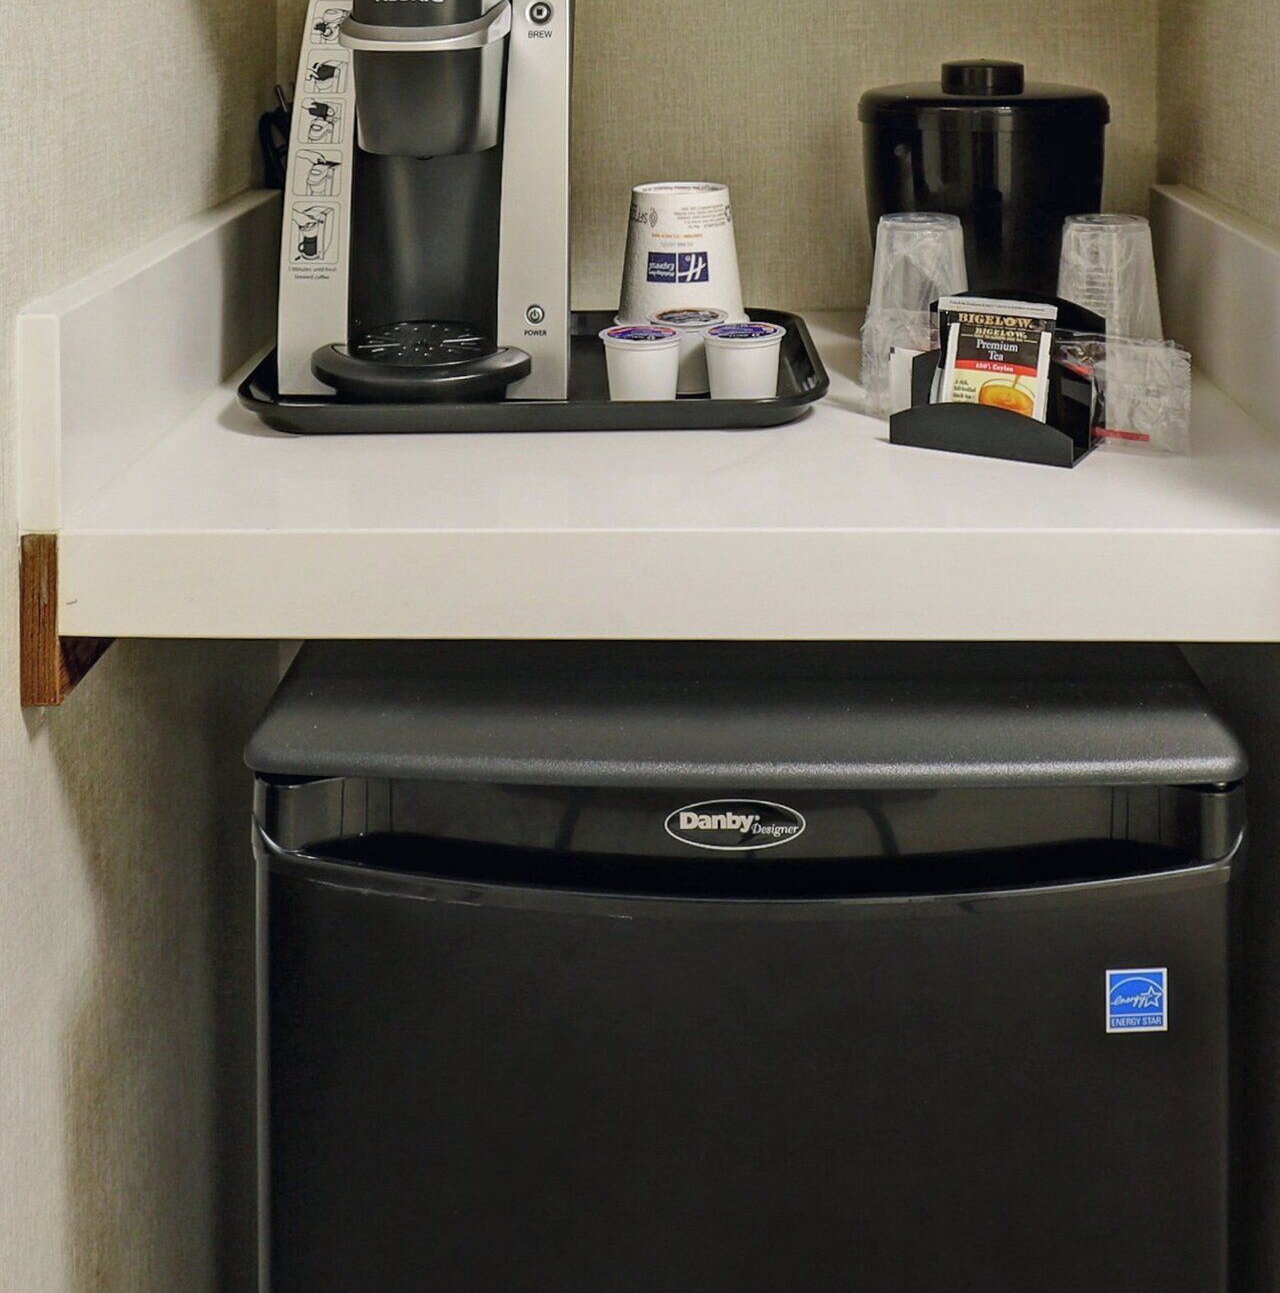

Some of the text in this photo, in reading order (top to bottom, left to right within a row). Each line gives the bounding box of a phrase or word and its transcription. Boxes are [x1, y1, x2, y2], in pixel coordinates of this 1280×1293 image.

[527, 30, 552, 39] BREW
[958, 313, 1032, 328] BIGELOW
[975, 327, 1027, 339] BIGELOW
[976, 339, 1018, 352] Premium
[988, 350, 1004, 361] Tea
[679, 812, 799, 837] Danby Designer
[1111, 1016, 1161, 1026] ENERGY STAR
